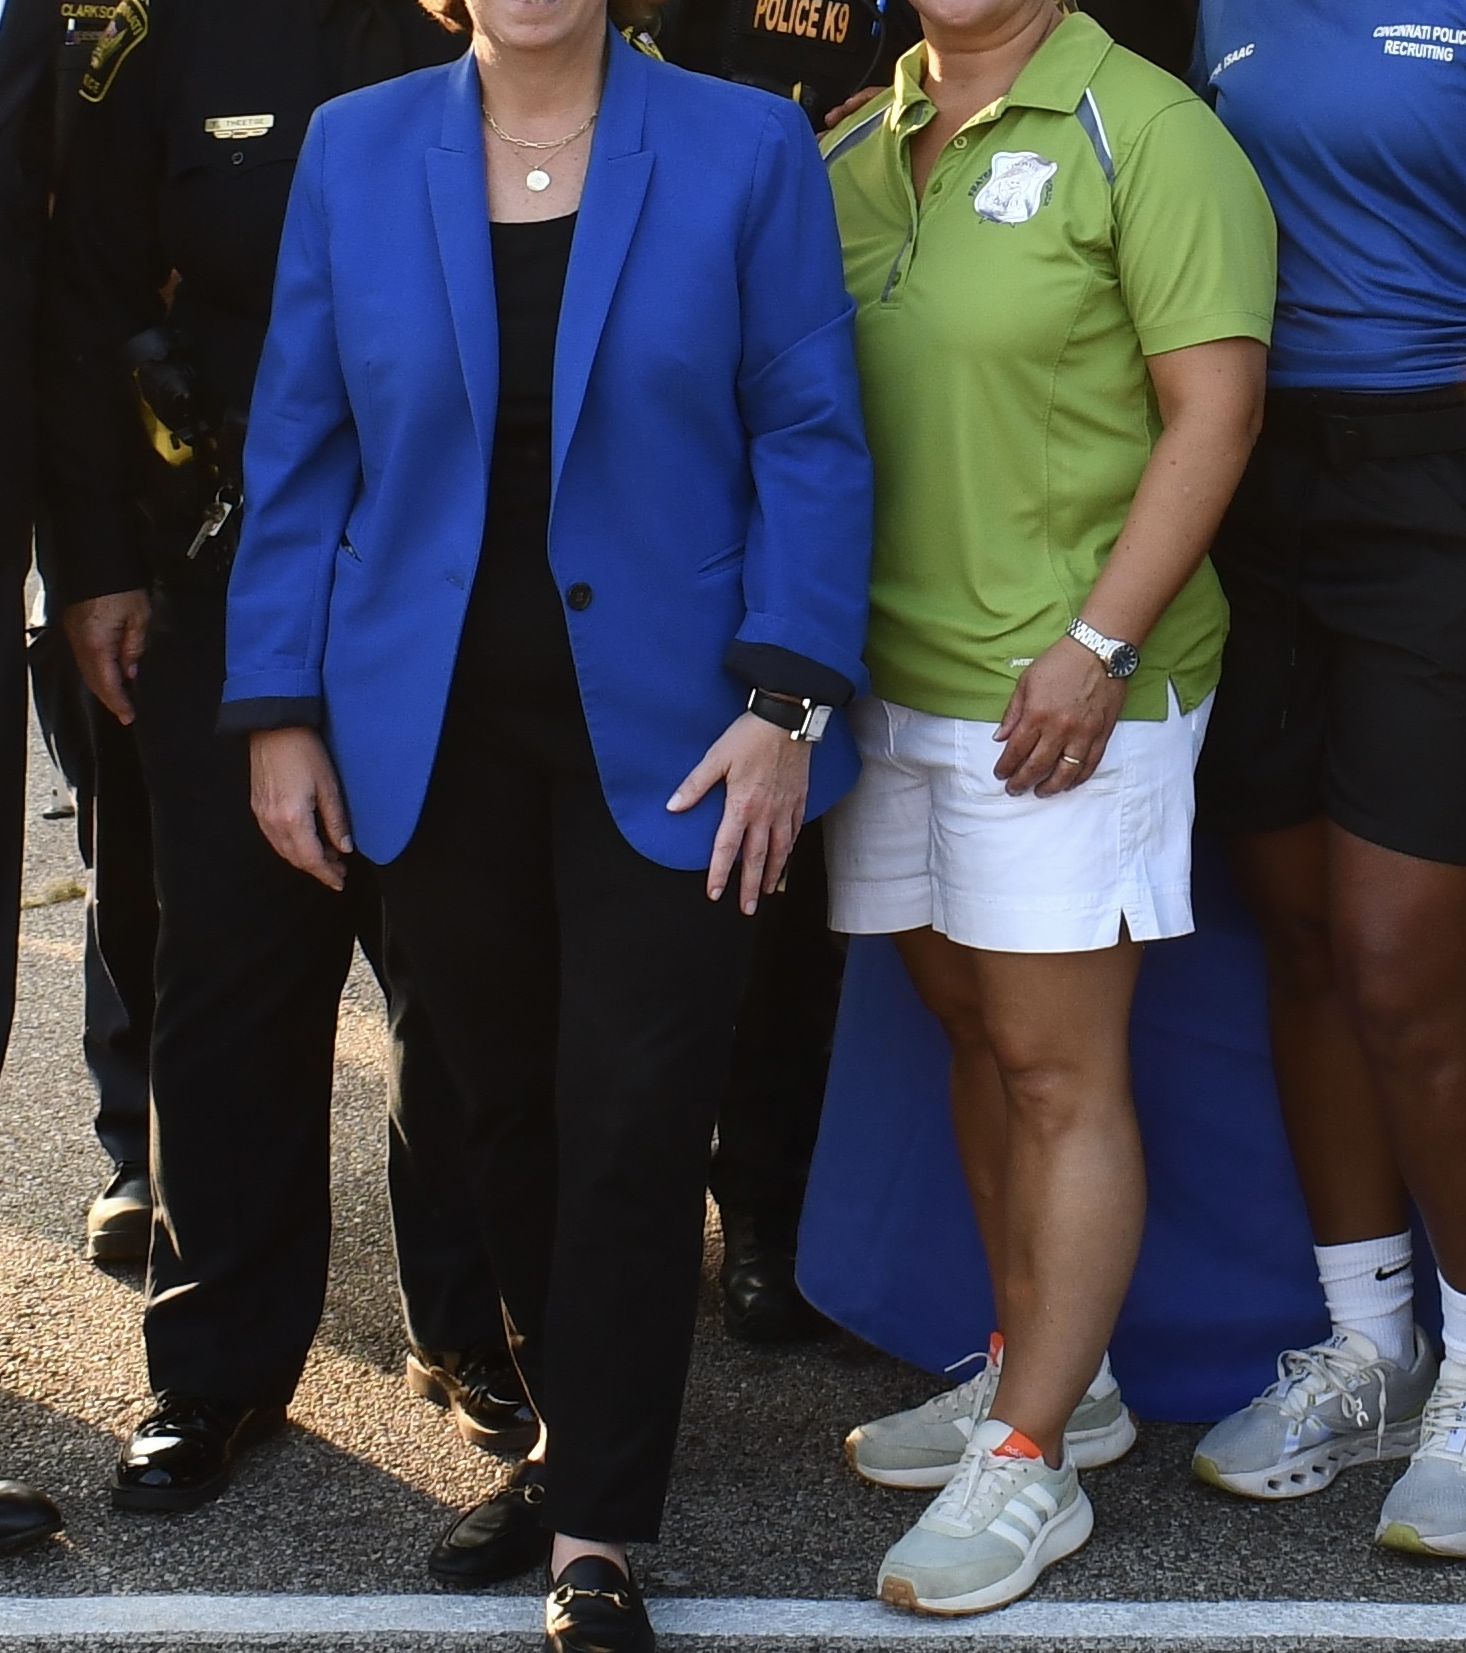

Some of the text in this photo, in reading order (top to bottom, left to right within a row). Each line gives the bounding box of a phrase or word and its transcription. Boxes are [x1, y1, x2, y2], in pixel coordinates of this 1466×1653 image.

[60, 3, 116, 19] CLARKSO
[821, 1, 851, 44] K9
[1373, 24, 1431, 41] CINCINNATI
[1224, 43, 1255, 69] ISAAC
[1384, 39, 1453, 62] RECRUITING
